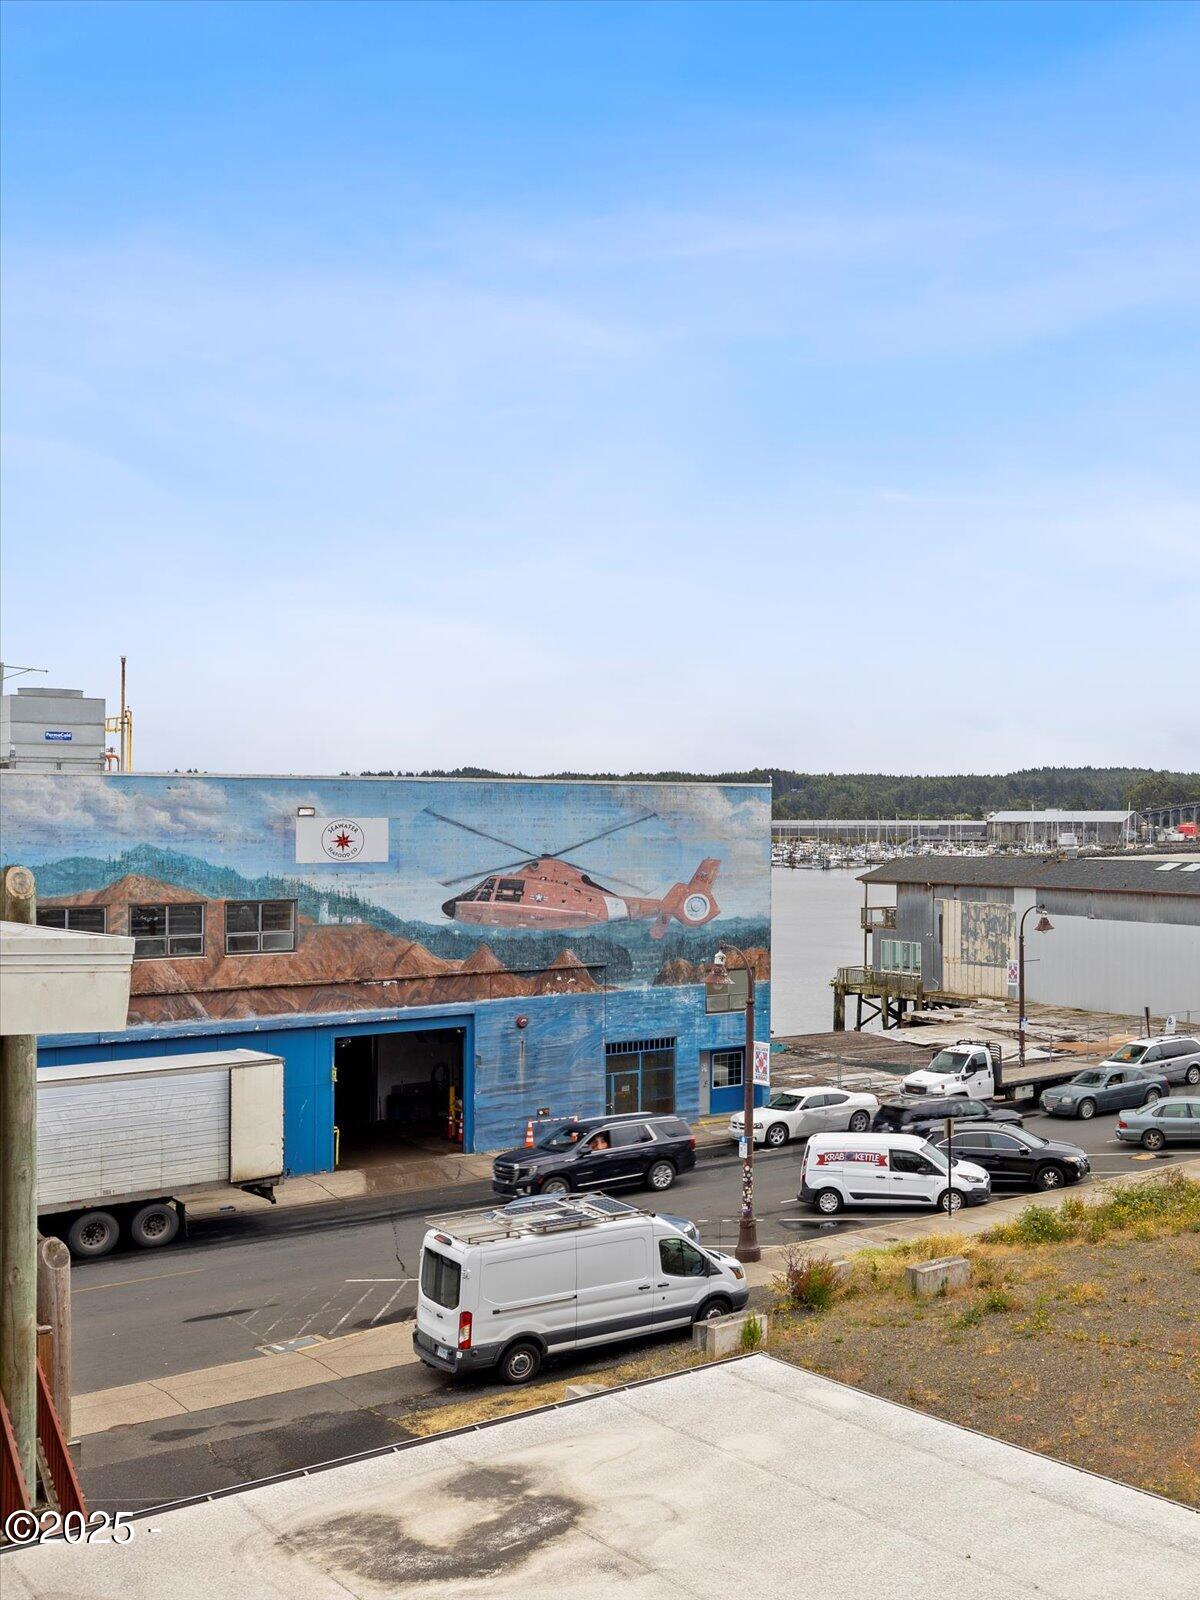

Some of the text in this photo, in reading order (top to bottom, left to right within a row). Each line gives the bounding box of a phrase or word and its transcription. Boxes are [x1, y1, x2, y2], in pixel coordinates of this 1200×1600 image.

[328, 823, 359, 833] SEAWATER
[328, 846, 350, 858] SEAFOOD
[824, 1152, 880, 1162] KRAB KETTLE
